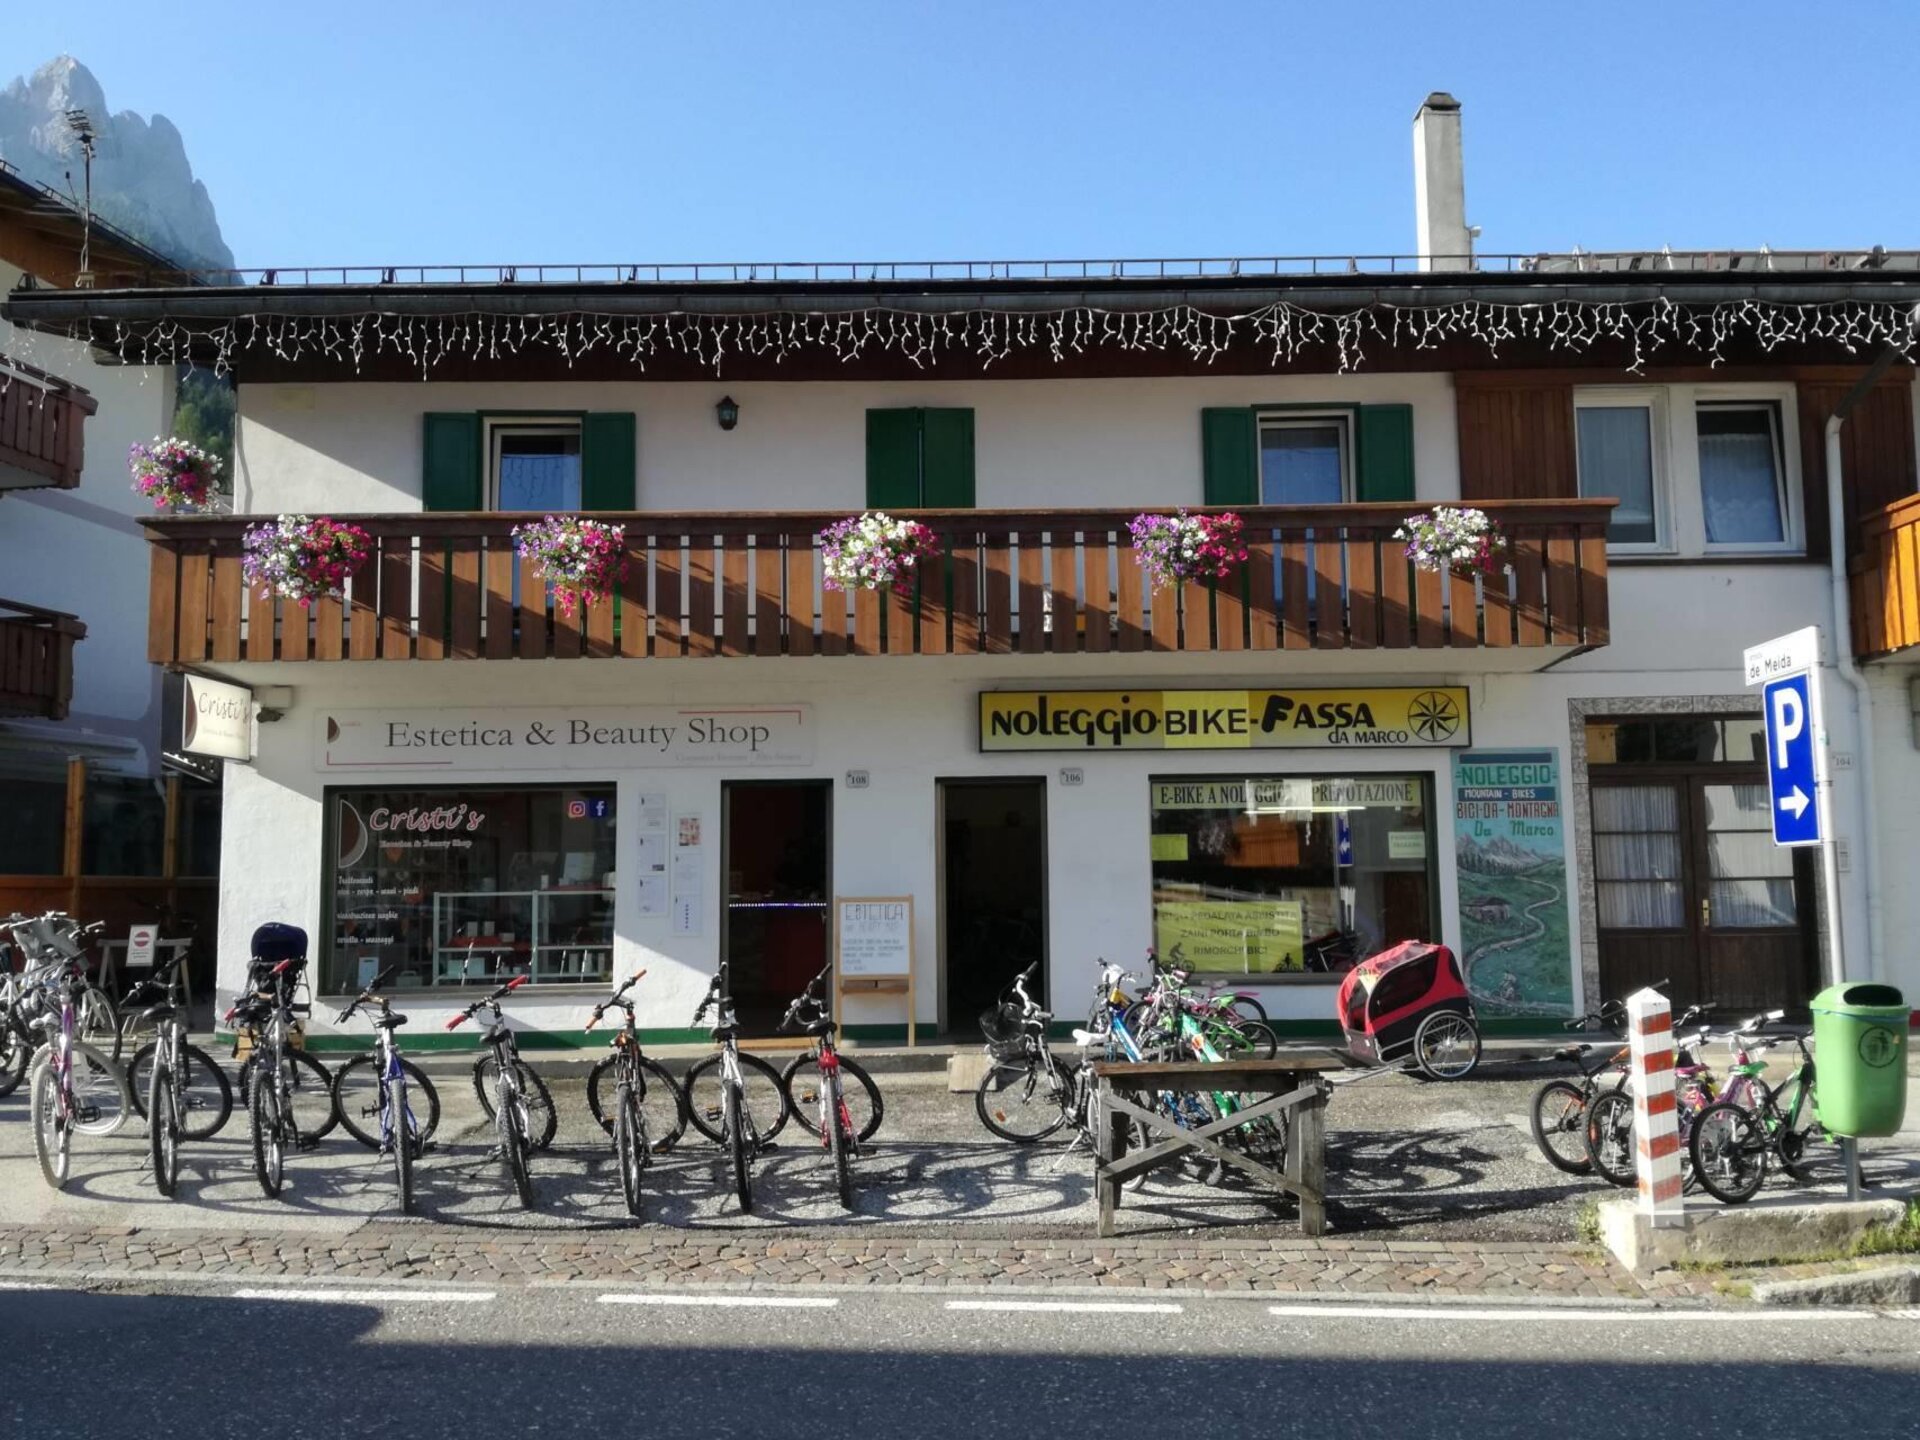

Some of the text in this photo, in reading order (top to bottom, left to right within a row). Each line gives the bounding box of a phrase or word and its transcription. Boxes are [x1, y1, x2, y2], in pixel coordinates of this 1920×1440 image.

[1750, 662, 1761, 679] de
[1261, 694, 1377, 733] FASSA
[384, 717, 769, 752] Estetica & Beauty Shop
[1354, 730, 1408, 744] MARCO
[1773, 687, 1804, 770] P
[1161, 786, 1204, 804] E-BIKE
[1207, 785, 1217, 804] A
[1464, 788, 1503, 799] MOUNTAIN
[1512, 788, 1536, 799] BIKES
[369, 803, 486, 832] Cristi's
[1510, 820, 1554, 836] Marco
